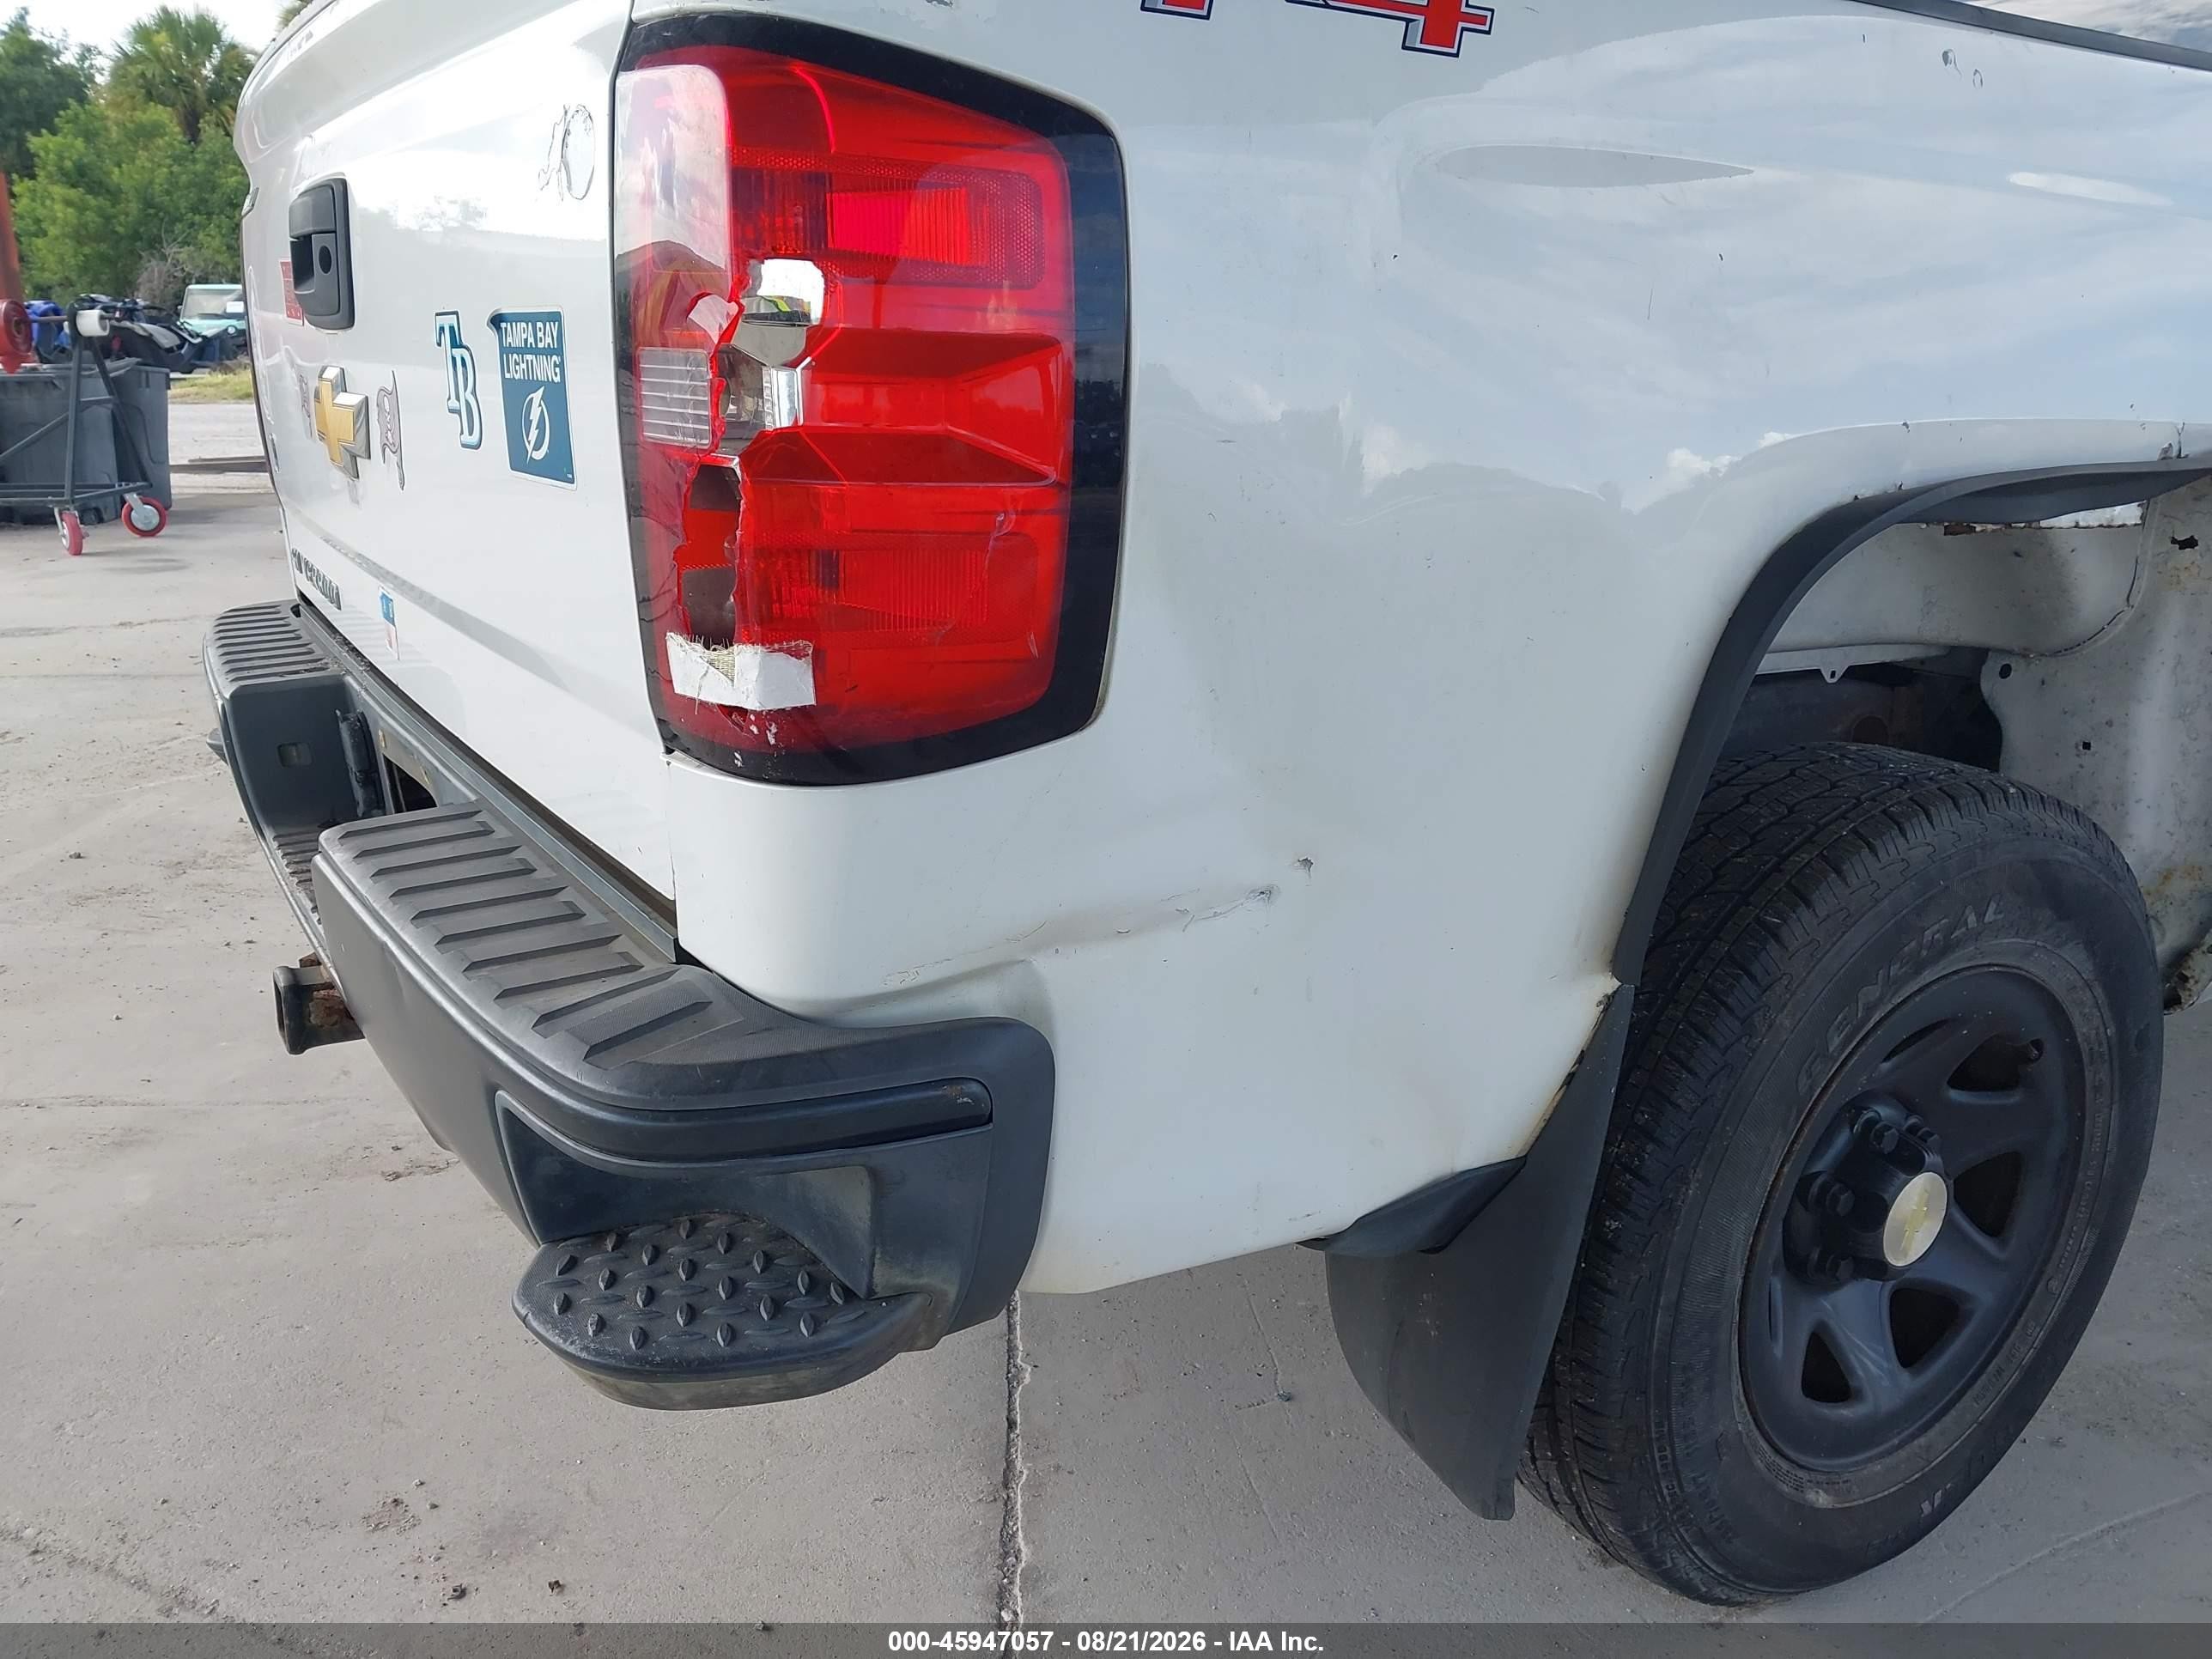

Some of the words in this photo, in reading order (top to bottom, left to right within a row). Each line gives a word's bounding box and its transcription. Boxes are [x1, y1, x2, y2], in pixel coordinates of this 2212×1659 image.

[500, 321, 533, 348] TAMPA
[536, 321, 559, 349] BAY
[502, 353, 561, 383] LIGHTNING
